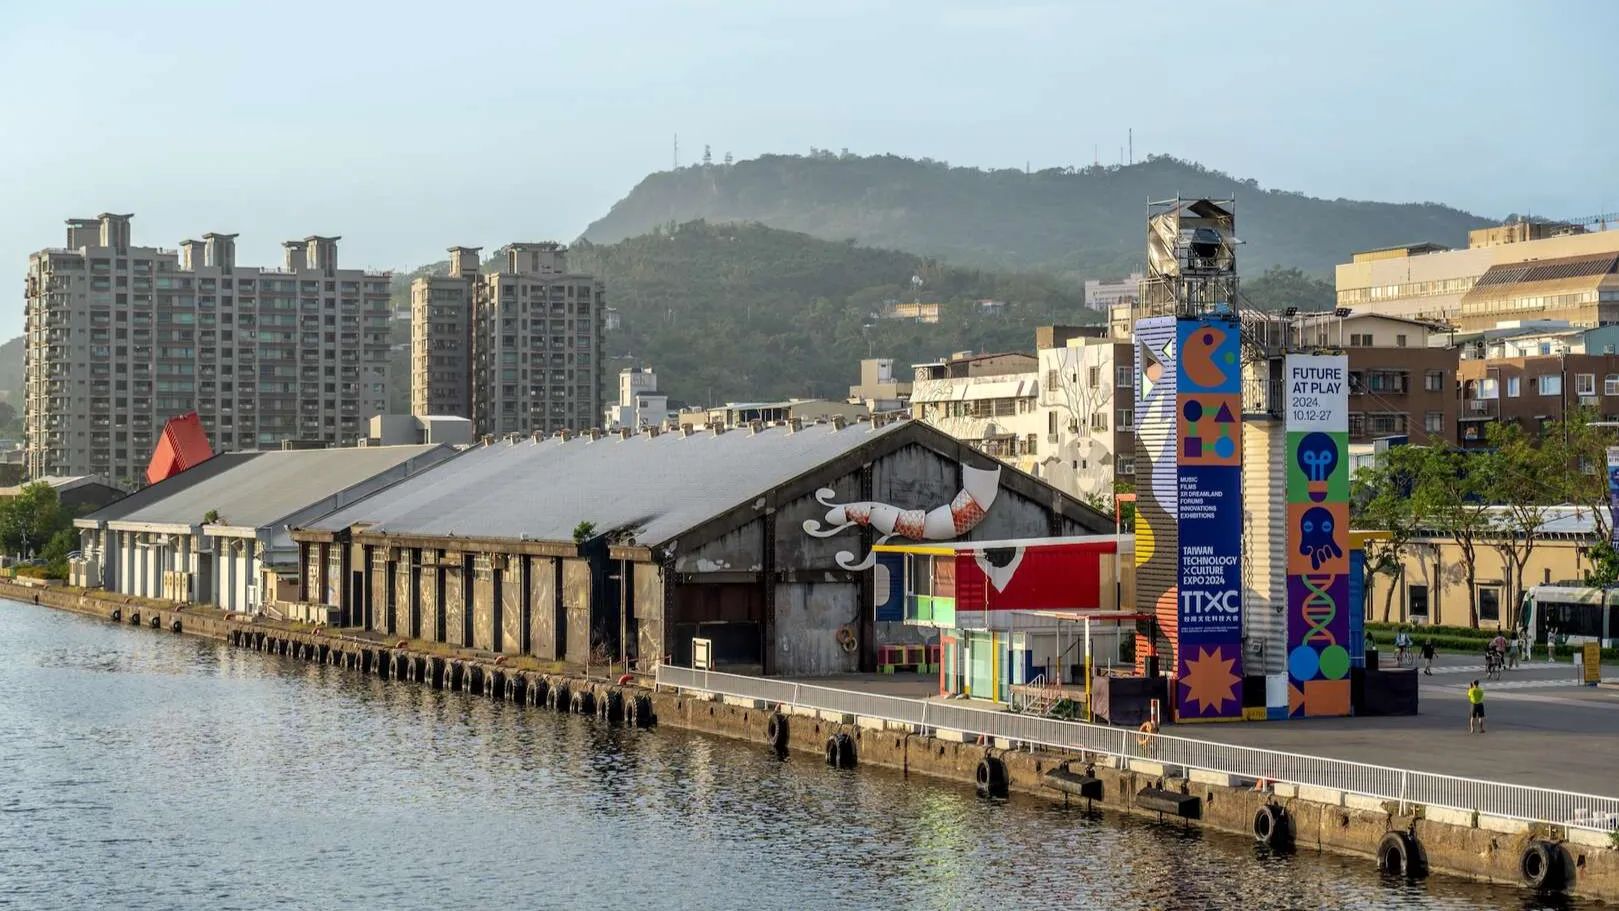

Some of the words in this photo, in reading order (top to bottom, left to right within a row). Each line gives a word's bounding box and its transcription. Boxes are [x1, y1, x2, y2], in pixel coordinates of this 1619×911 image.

[1292, 367, 1342, 380] FUTURE
[1292, 382, 1309, 394] AT
[1311, 382, 1341, 394] PLAY
[1293, 410, 1332, 421] 10.12-27
[1183, 546, 1214, 555] TAIWAN
[1183, 556, 1238, 566] TECHNOLOGY
[1183, 576, 1205, 585] EXPO
[1205, 576, 1226, 585] 2024
[1181, 589, 1239, 614] TTXC
